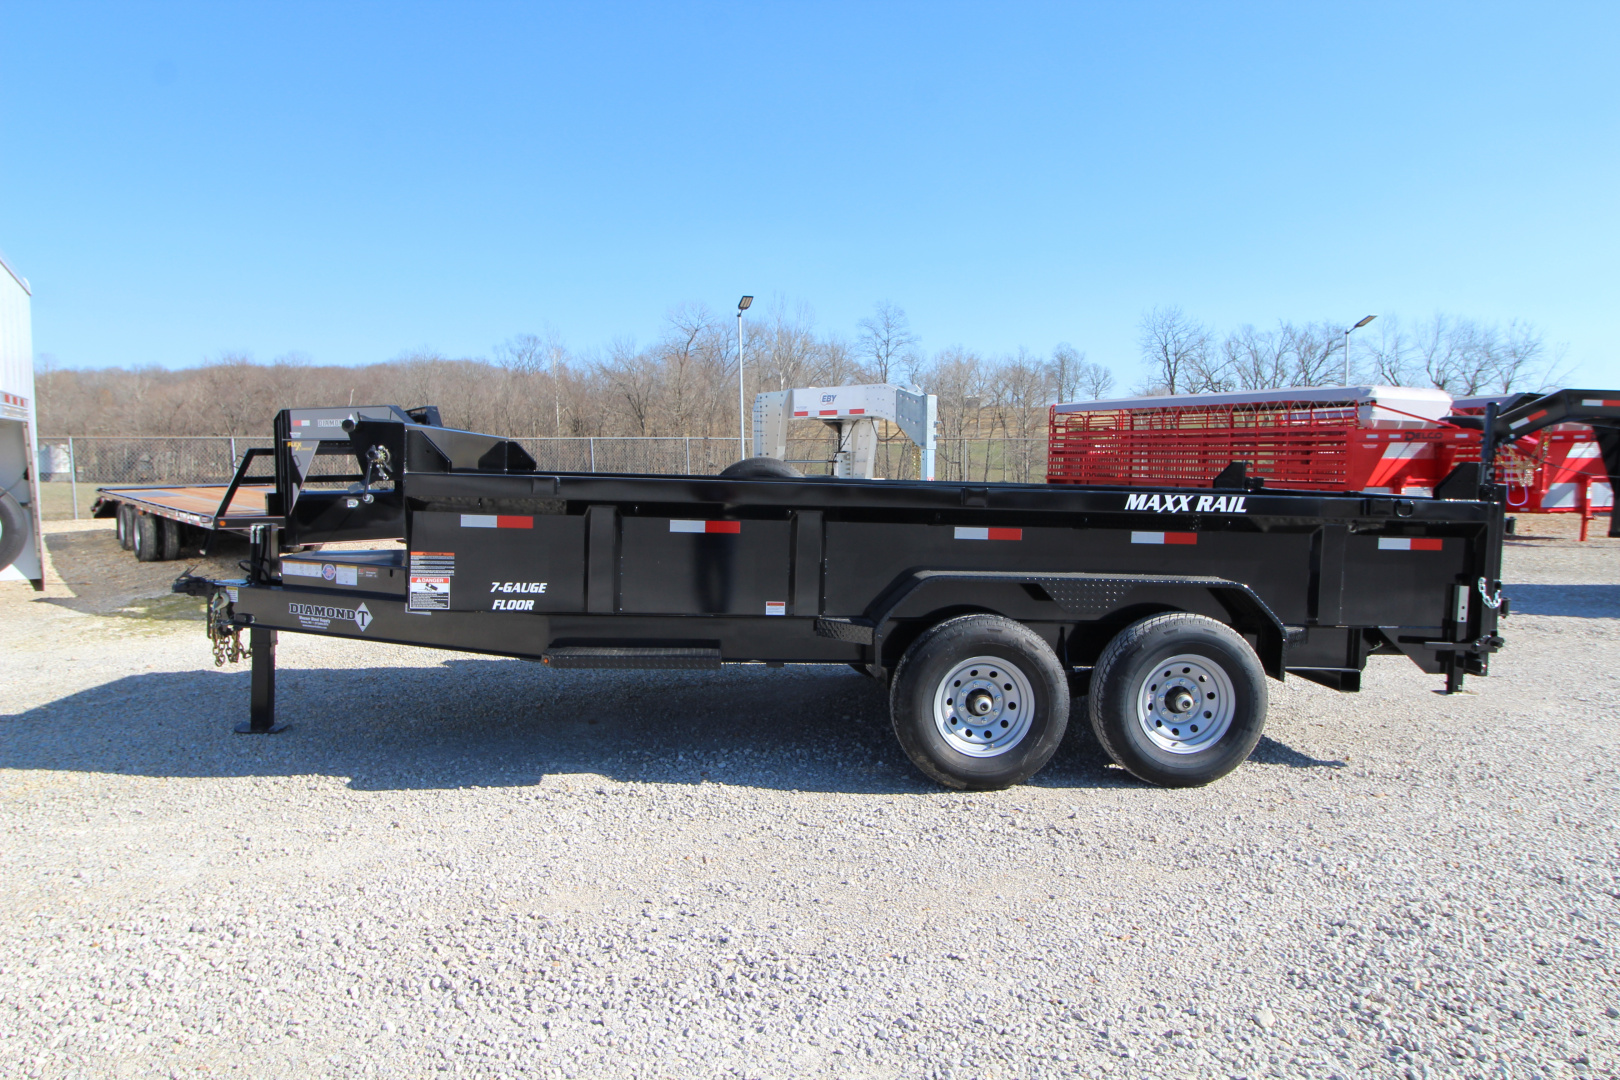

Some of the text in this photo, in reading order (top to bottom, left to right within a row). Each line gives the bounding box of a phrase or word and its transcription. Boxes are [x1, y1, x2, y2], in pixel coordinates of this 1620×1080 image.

[821, 394, 837, 402] EBY
[1124, 493, 1247, 513] MAXX RAIL
[490, 581, 548, 594] 7-GAUGE
[289, 603, 356, 620] DIAMOND
[491, 599, 535, 611] FLOOR
